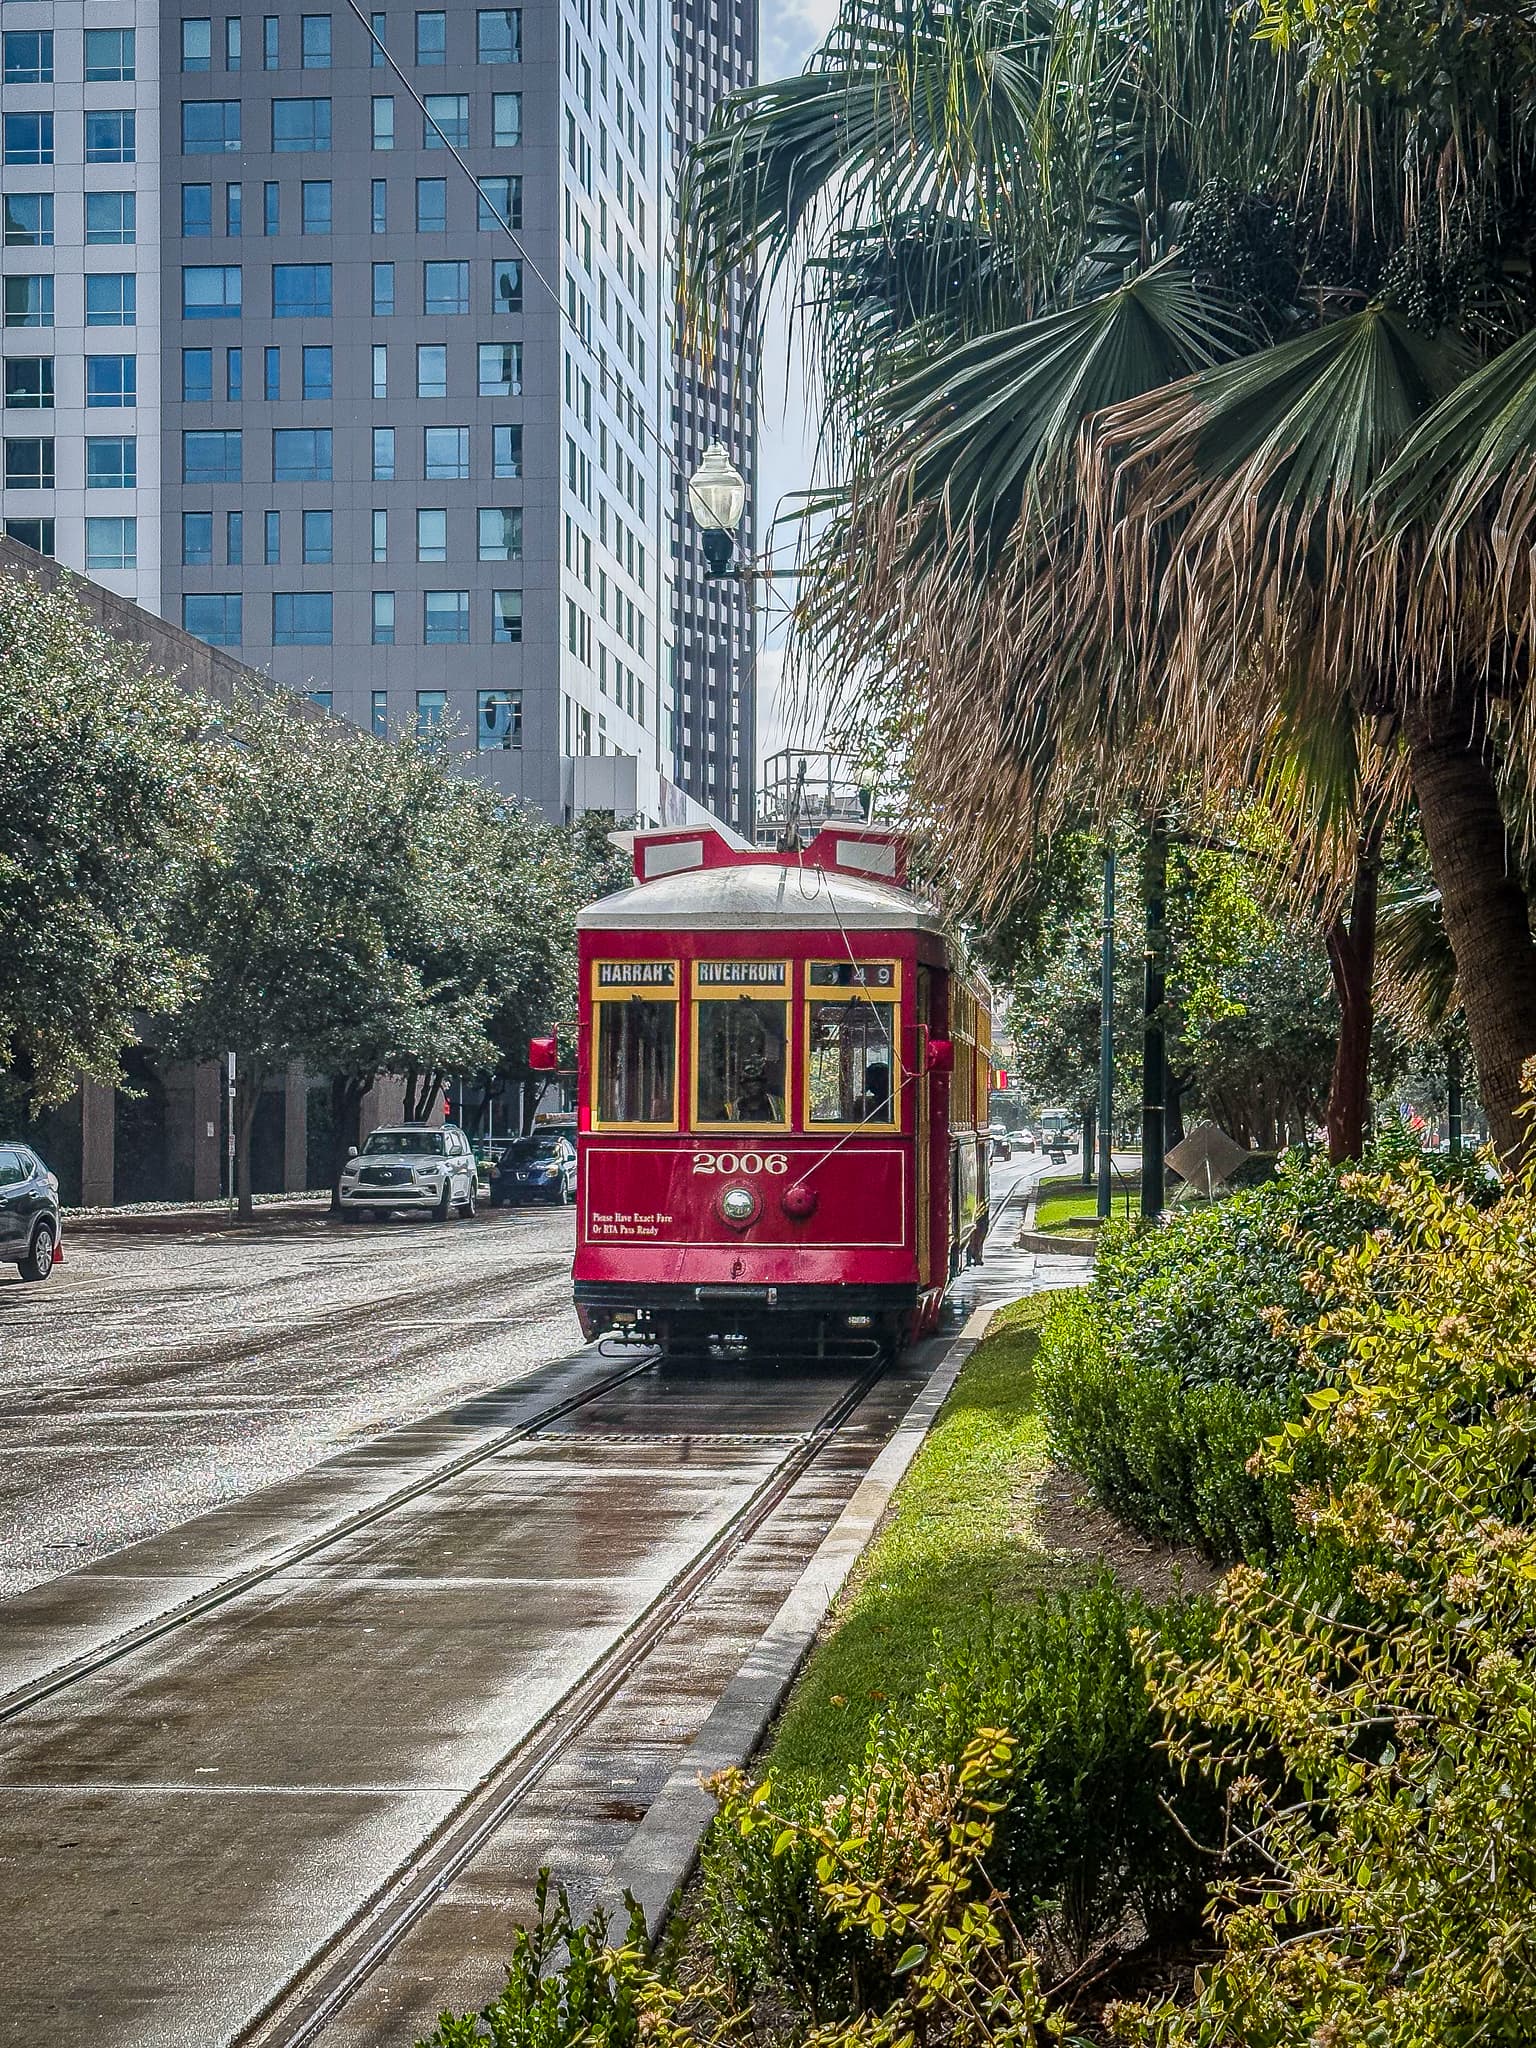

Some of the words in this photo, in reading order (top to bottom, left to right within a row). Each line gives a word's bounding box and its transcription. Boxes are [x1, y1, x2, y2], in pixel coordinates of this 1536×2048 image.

[602, 964, 674, 982] HARRAH'S
[700, 963, 785, 981] RIVERFRONT
[693, 1152, 788, 1175] 2006
[592, 1212, 613, 1222] Please
[615, 1212, 632, 1222] Have
[634, 1212, 655, 1223] Exact
[656, 1213, 673, 1223] Fare
[592, 1224, 602, 1234] Or
[603, 1224, 618, 1234] RTA
[620, 1225, 635, 1235] Pass
[637, 1225, 659, 1236] Ready
